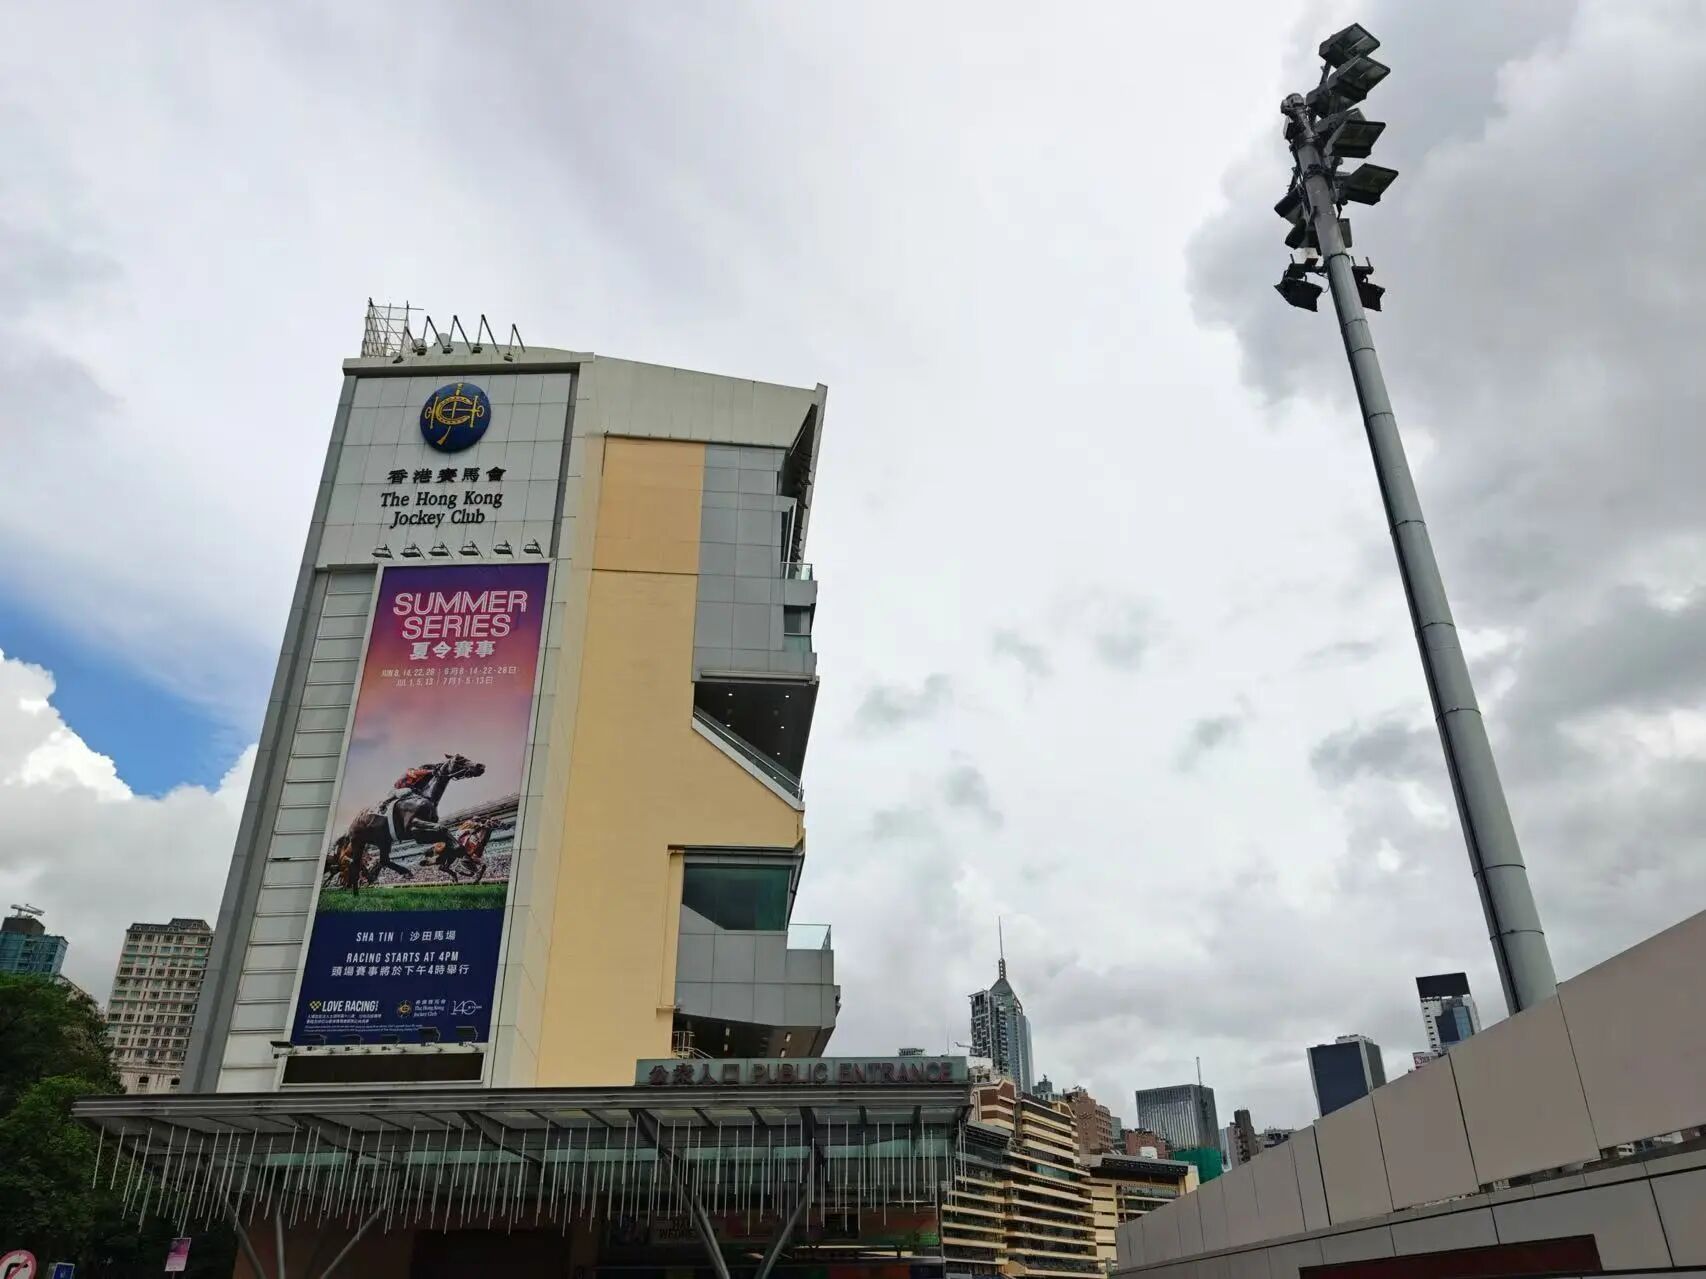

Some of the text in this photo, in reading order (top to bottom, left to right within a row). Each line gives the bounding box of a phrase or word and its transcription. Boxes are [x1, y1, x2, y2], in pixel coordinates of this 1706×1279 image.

[387, 466, 507, 484] 香港賽馬會
[381, 490, 504, 509] The Hong Kong
[389, 508, 486, 529] Jockey Club
[393, 590, 528, 615] SUMMER
[402, 614, 511, 639] SERIES
[409, 640, 496, 661] 夏令賽事
[356, 931, 394, 942] SHA TIN
[409, 930, 457, 941] 沙田馬場
[346, 951, 459, 963] RACING STARTS AT 4PM
[322, 1000, 343, 1012] LOVE
[752, 1062, 953, 1084] PUBLIC ENTRANCE
